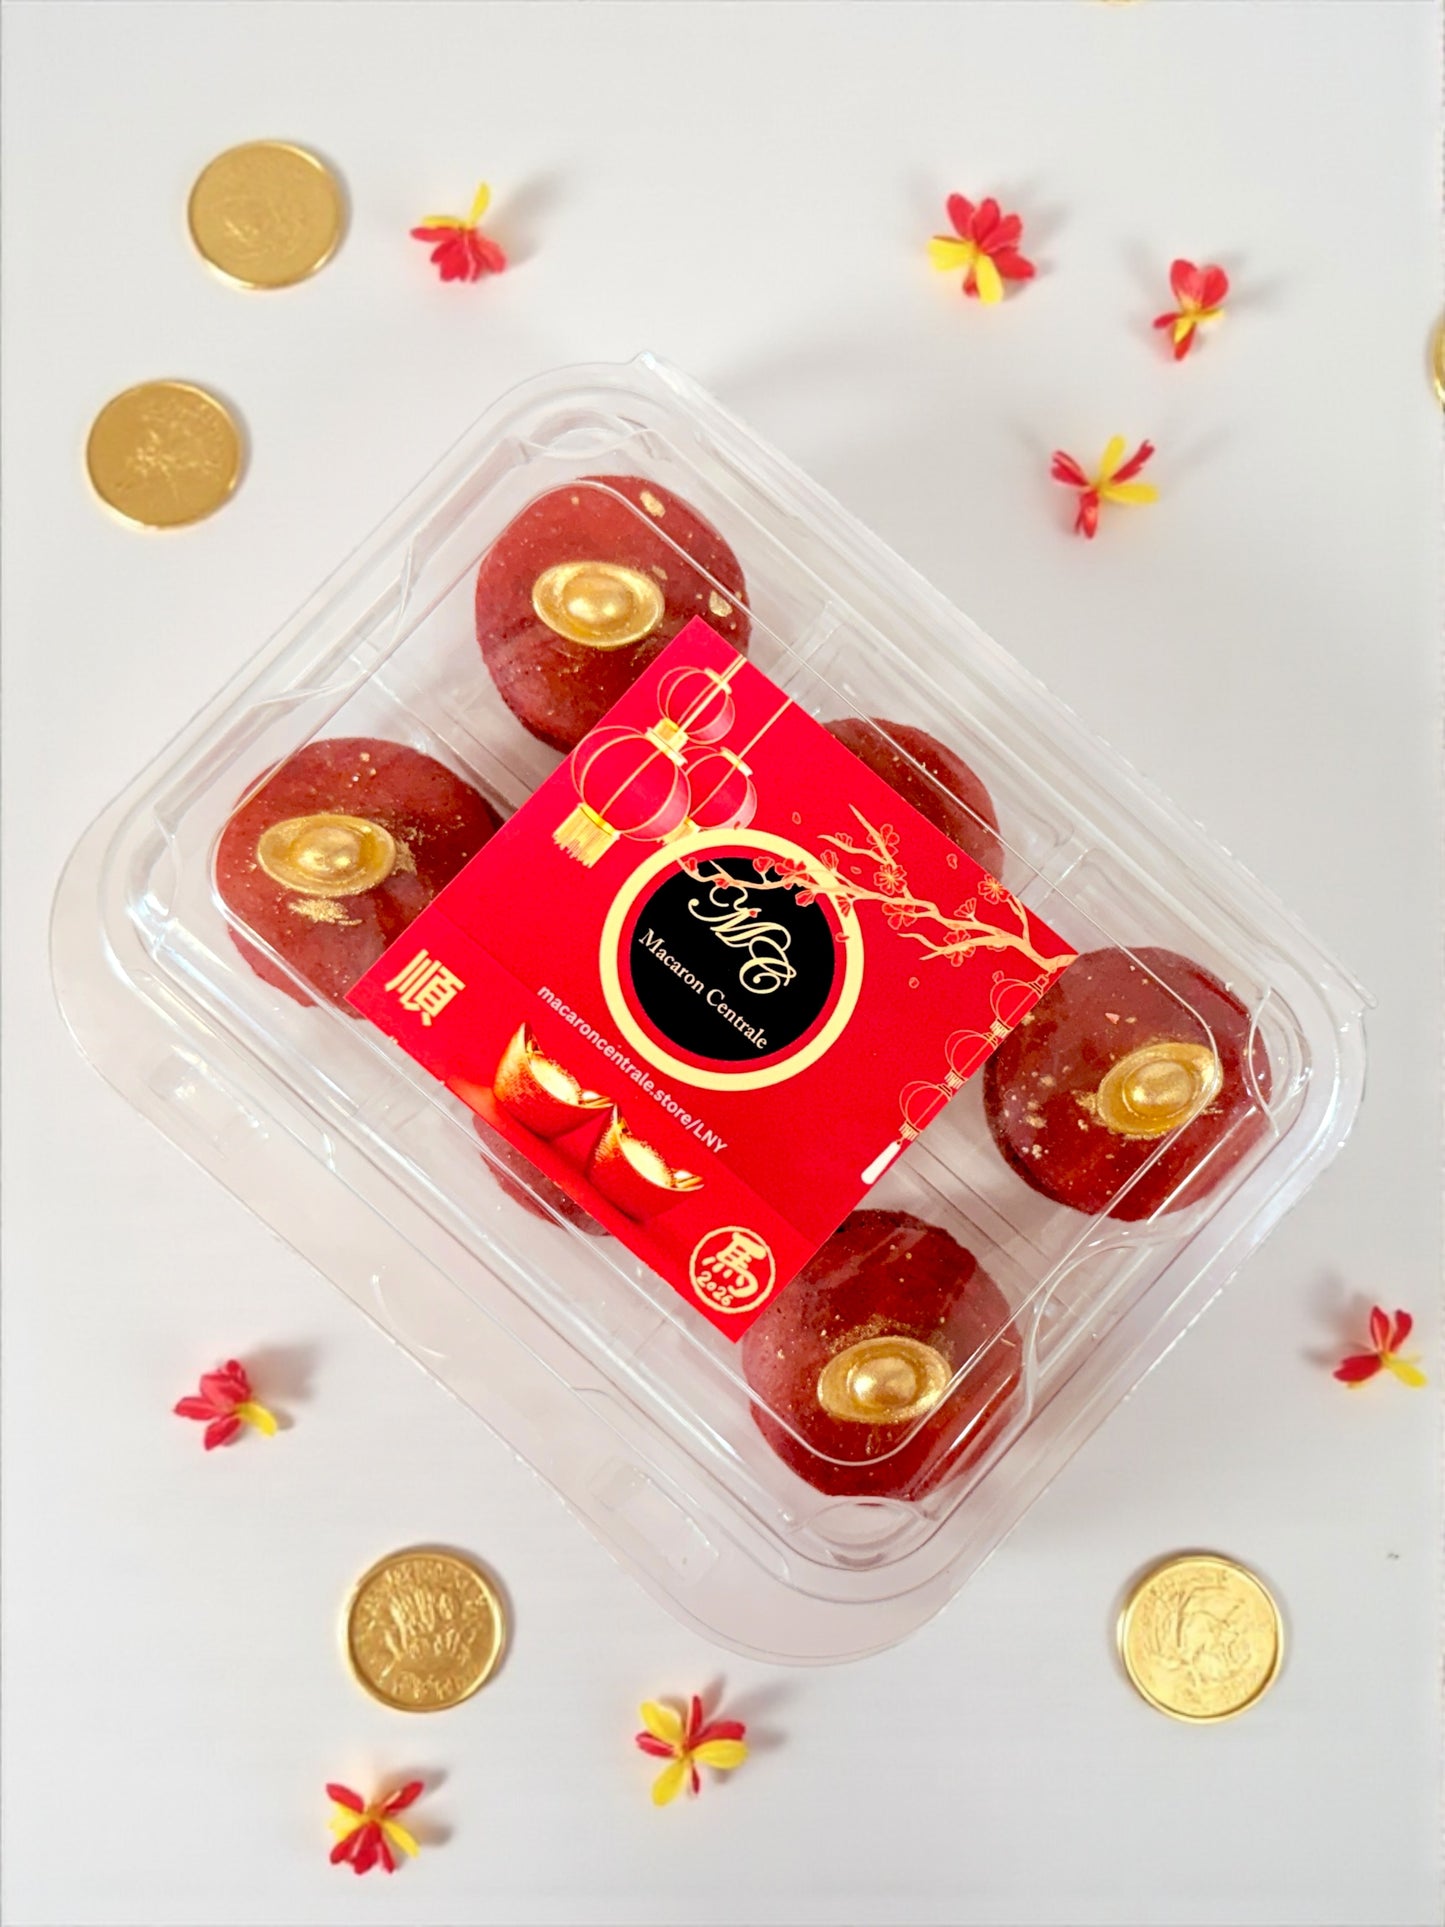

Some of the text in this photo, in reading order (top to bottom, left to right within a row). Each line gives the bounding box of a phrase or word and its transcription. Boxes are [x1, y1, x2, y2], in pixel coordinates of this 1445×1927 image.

[384, 948, 466, 1027] 順
[638, 928, 768, 1049] Macaron Centrale
[536, 985, 728, 1153] macaroncentrale.store/LNY
[696, 1270, 734, 1307] 2026
[701, 1231, 767, 1298] 馬
